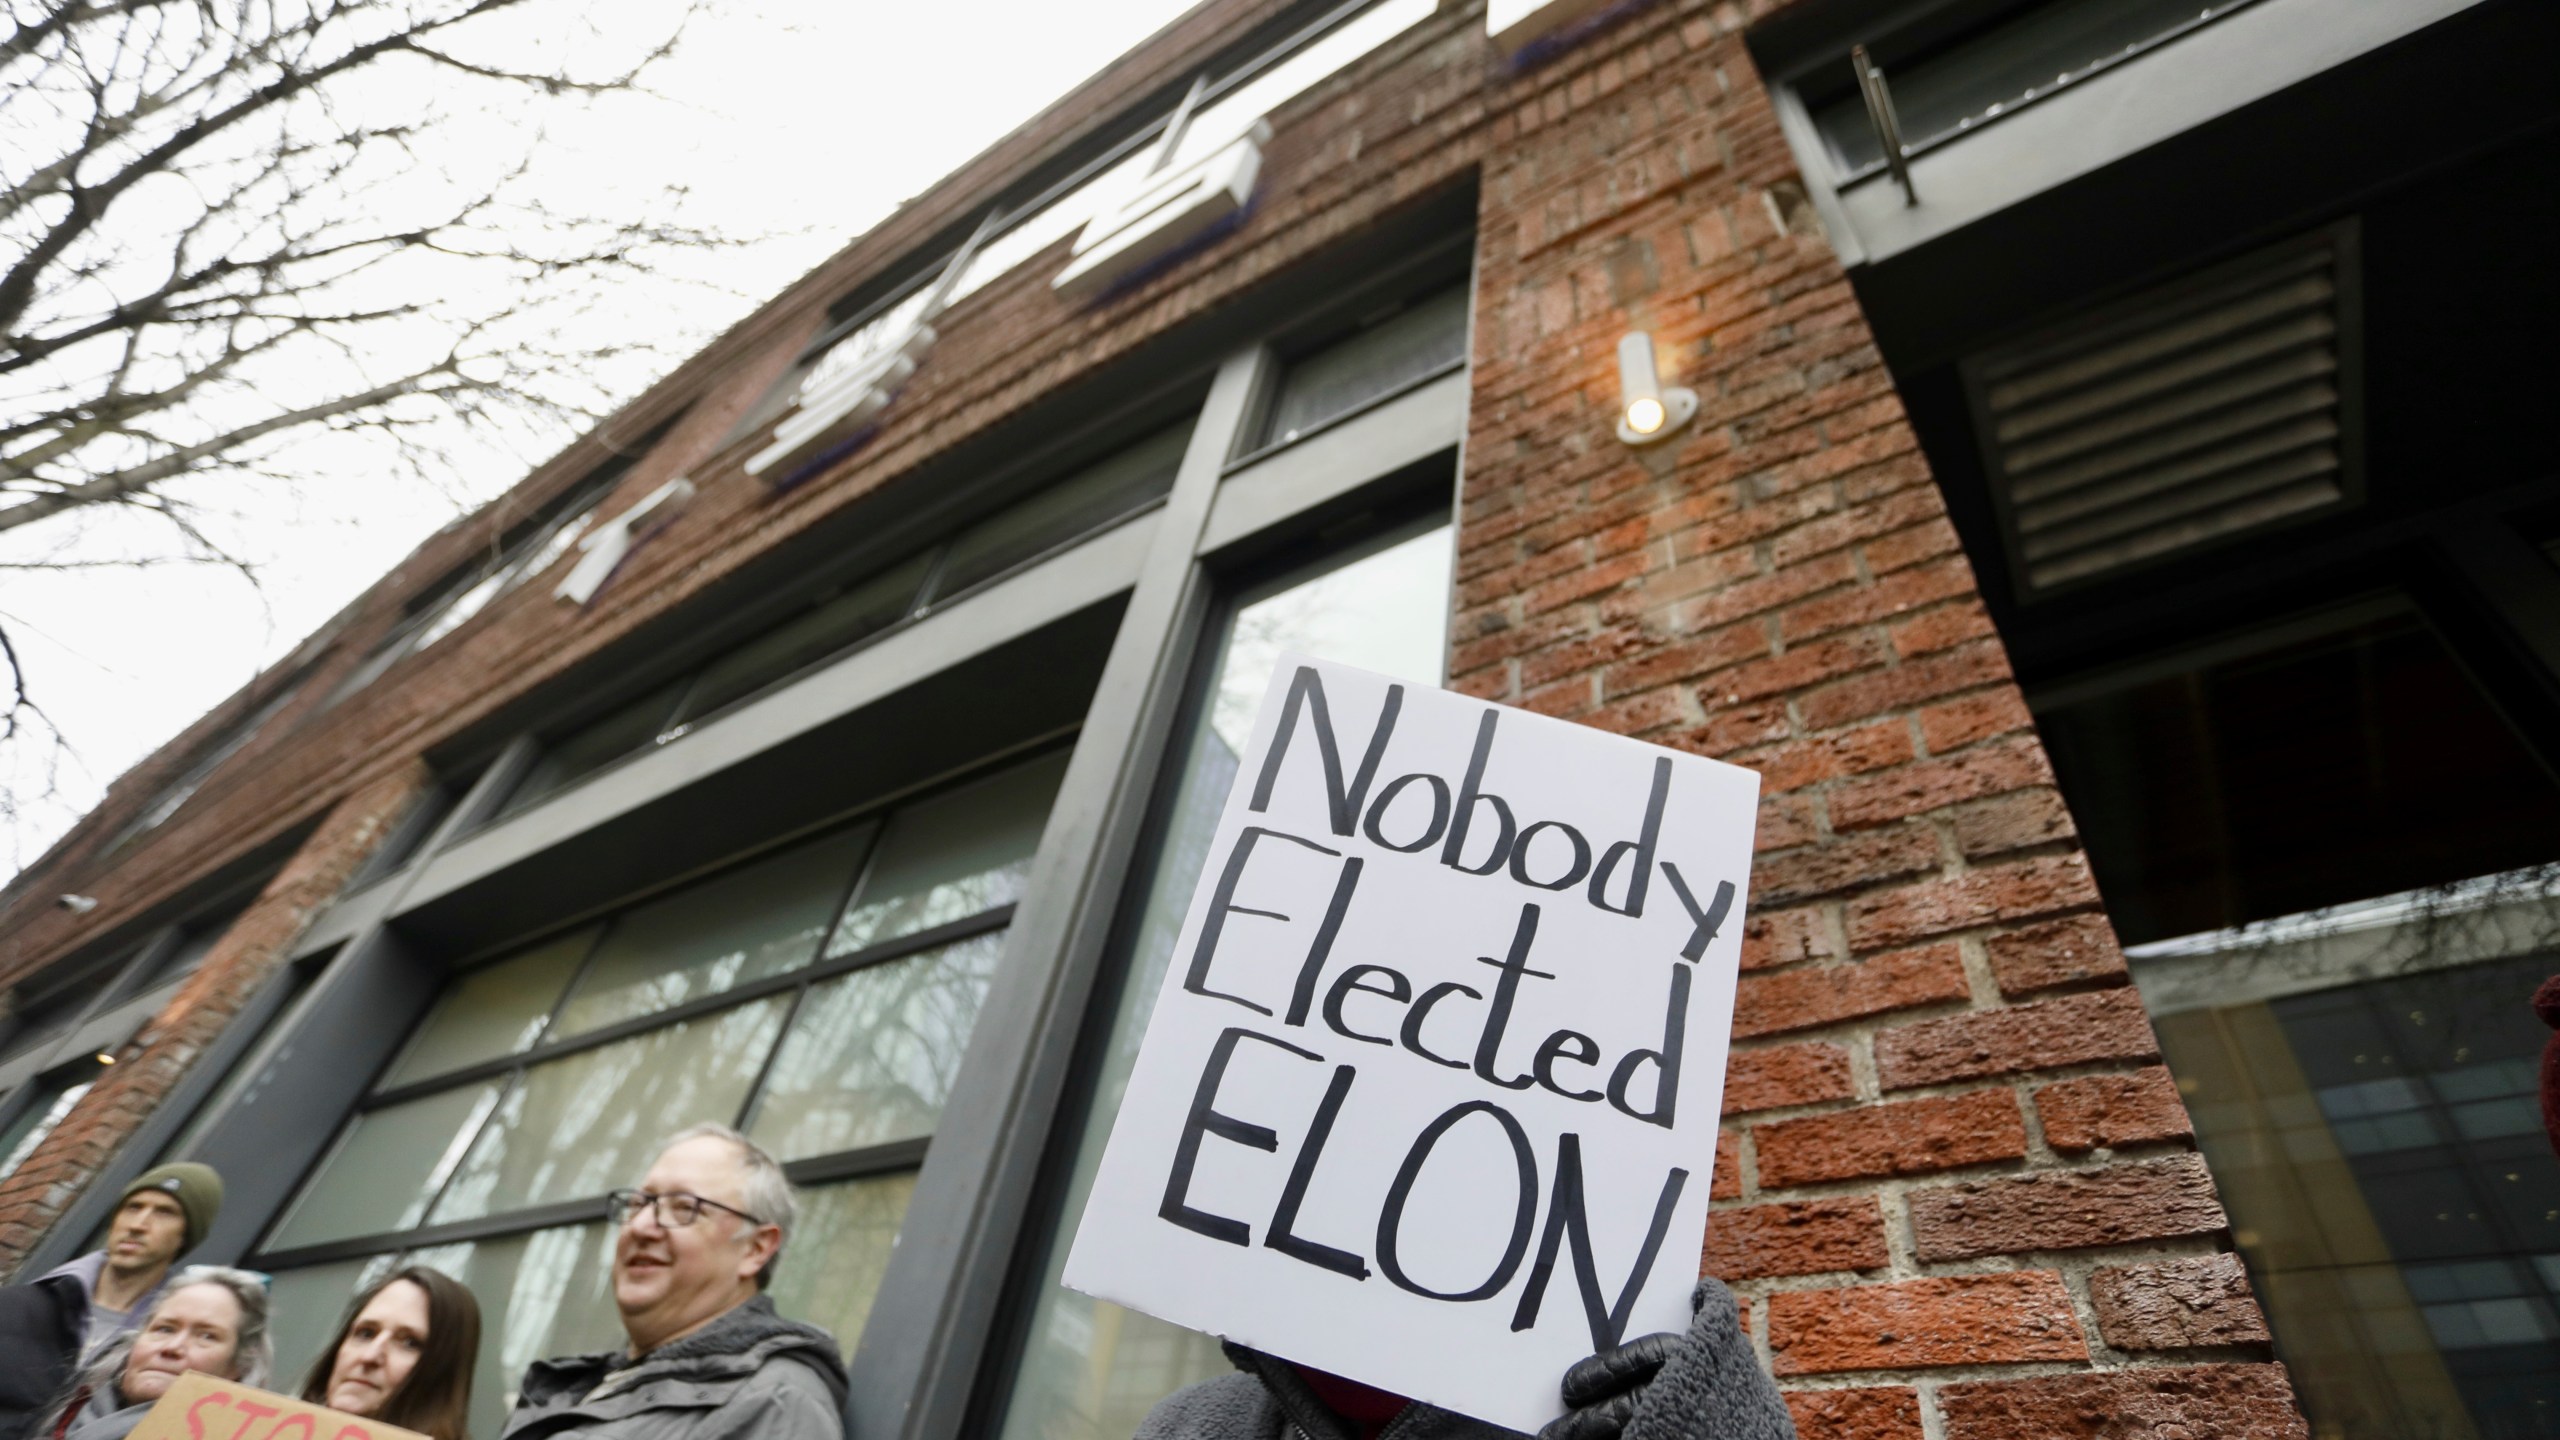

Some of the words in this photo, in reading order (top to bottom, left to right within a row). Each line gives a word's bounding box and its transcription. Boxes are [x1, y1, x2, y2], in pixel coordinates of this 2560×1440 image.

[1248, 666, 1736, 963] Nobody
[1183, 826, 1691, 1129] Elected
[1157, 1027, 1689, 1353] ELON
[159, 1391, 373, 1440] ST
